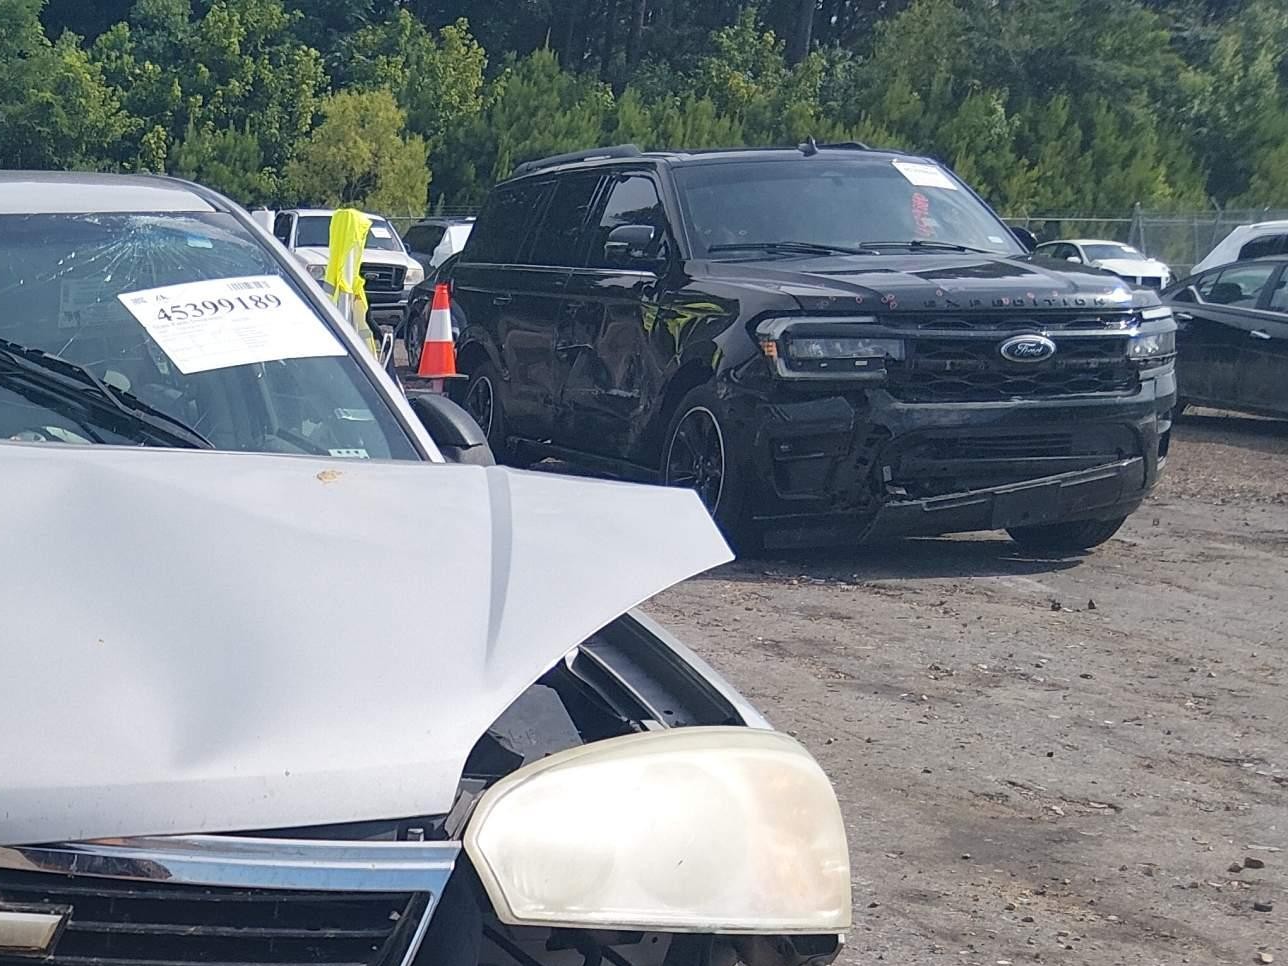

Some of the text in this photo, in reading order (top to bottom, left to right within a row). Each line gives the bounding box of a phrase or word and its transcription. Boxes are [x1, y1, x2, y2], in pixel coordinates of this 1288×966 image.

[157, 293, 282, 321] 45399189
[923, 299, 1106, 309] EXPEDITION
[1015, 343, 1044, 355] Ford
